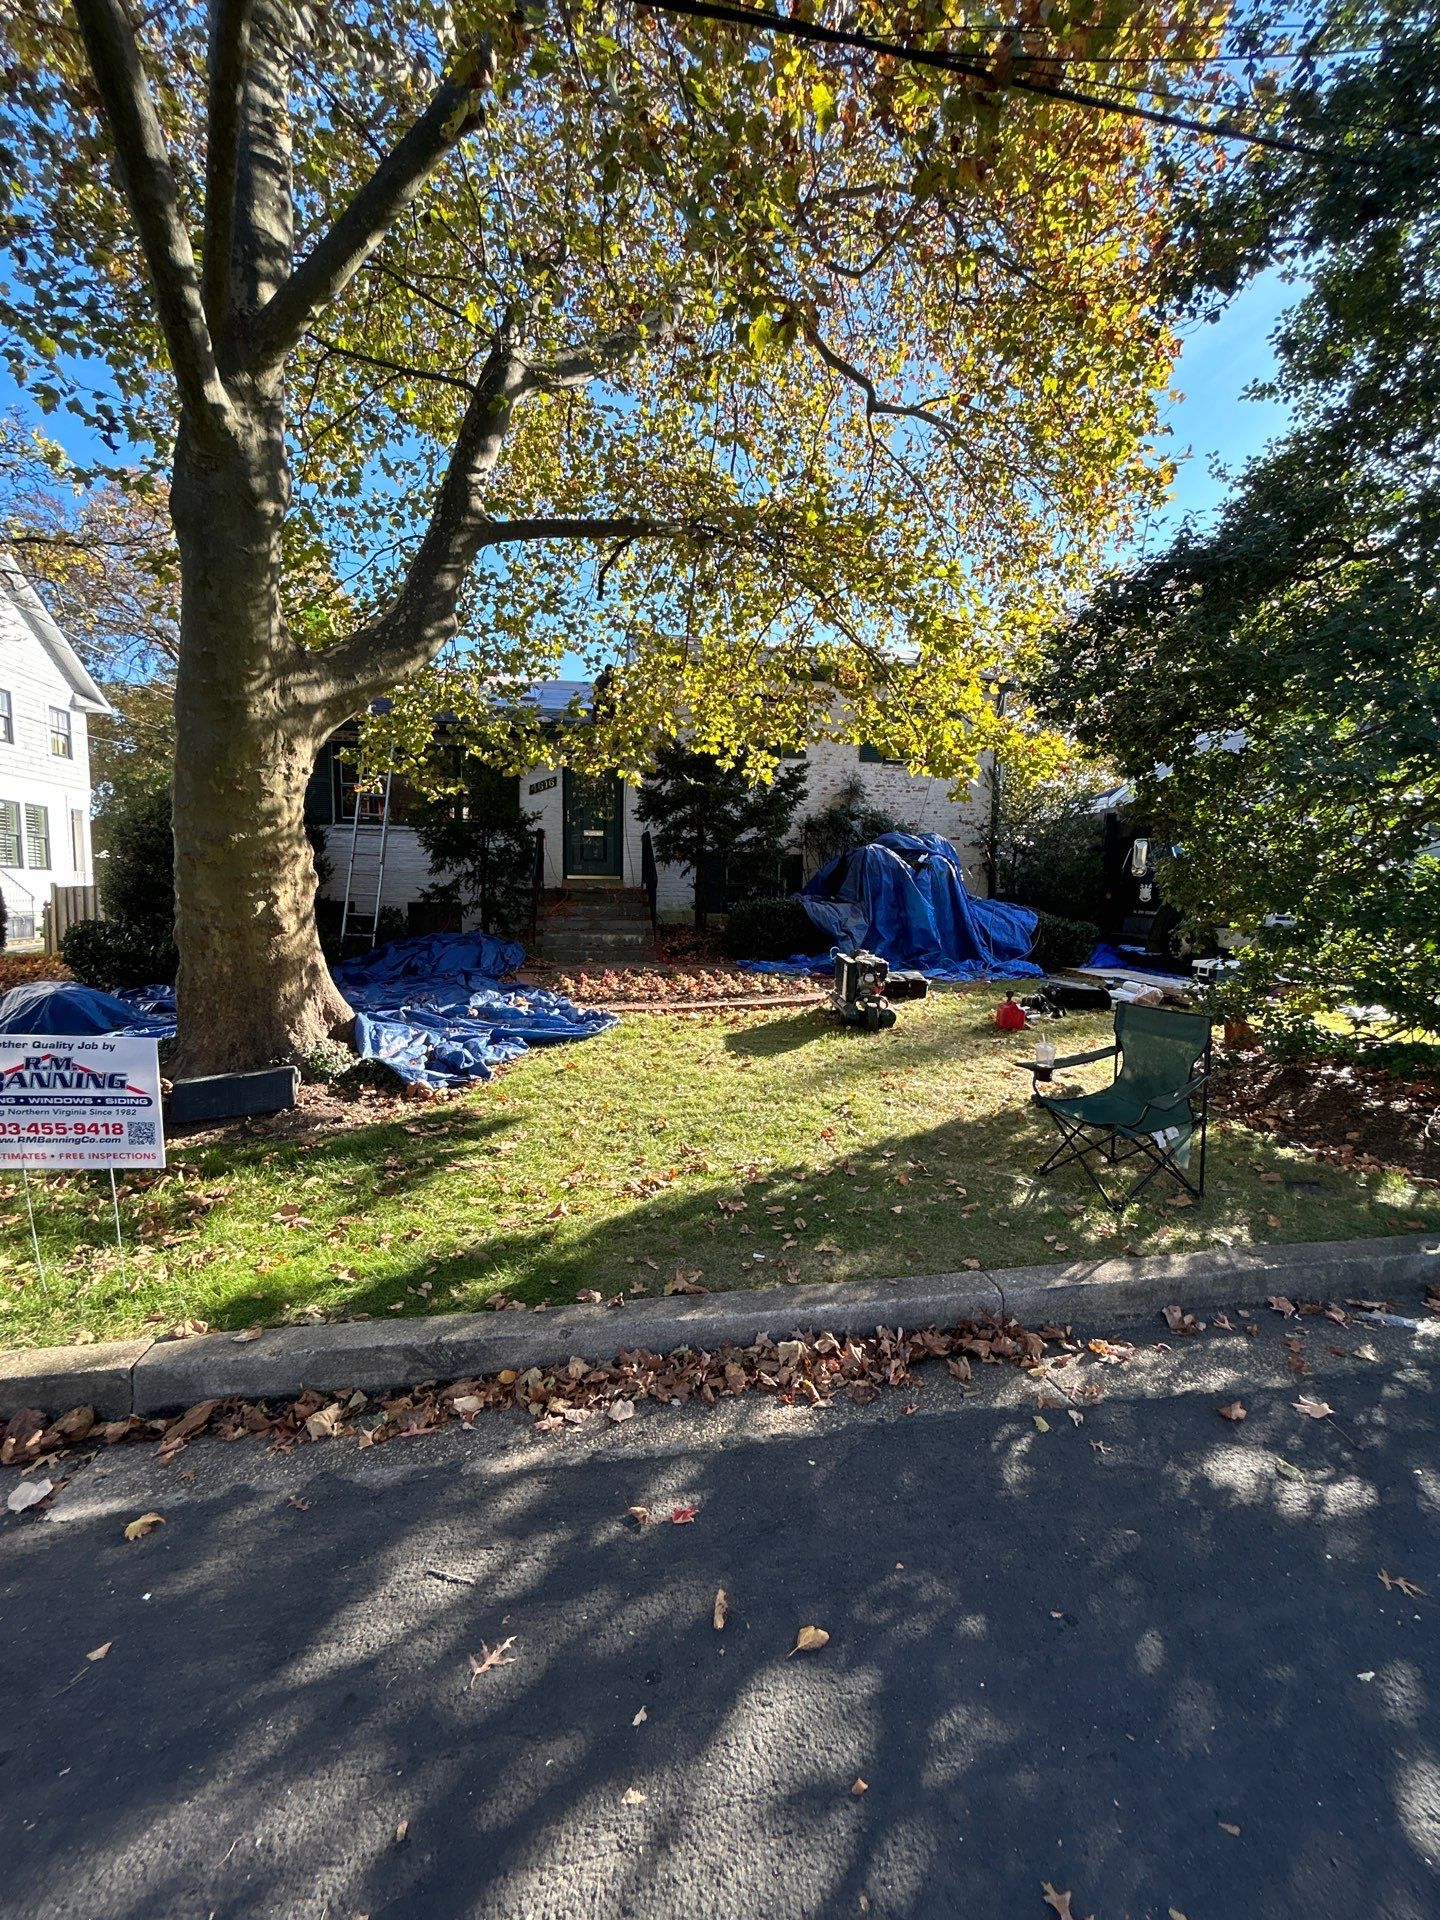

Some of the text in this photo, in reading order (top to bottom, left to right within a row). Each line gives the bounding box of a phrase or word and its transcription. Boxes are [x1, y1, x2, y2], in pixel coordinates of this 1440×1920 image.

[0, 1040, 116, 1052] ther Quality Job by
[24, 1055, 79, 1072] R.M.
[28, 1097, 93, 1105] WINDOWS
[105, 1097, 148, 1105] SIDING
[7, 1108, 50, 1116] Northern
[52, 1108, 87, 1117] Virginia
[89, 1108, 113, 1116] Since
[115, 1108, 137, 1116] 1982
[0, 1152, 157, 1160] TIMATES FREE INSPECTIONS
